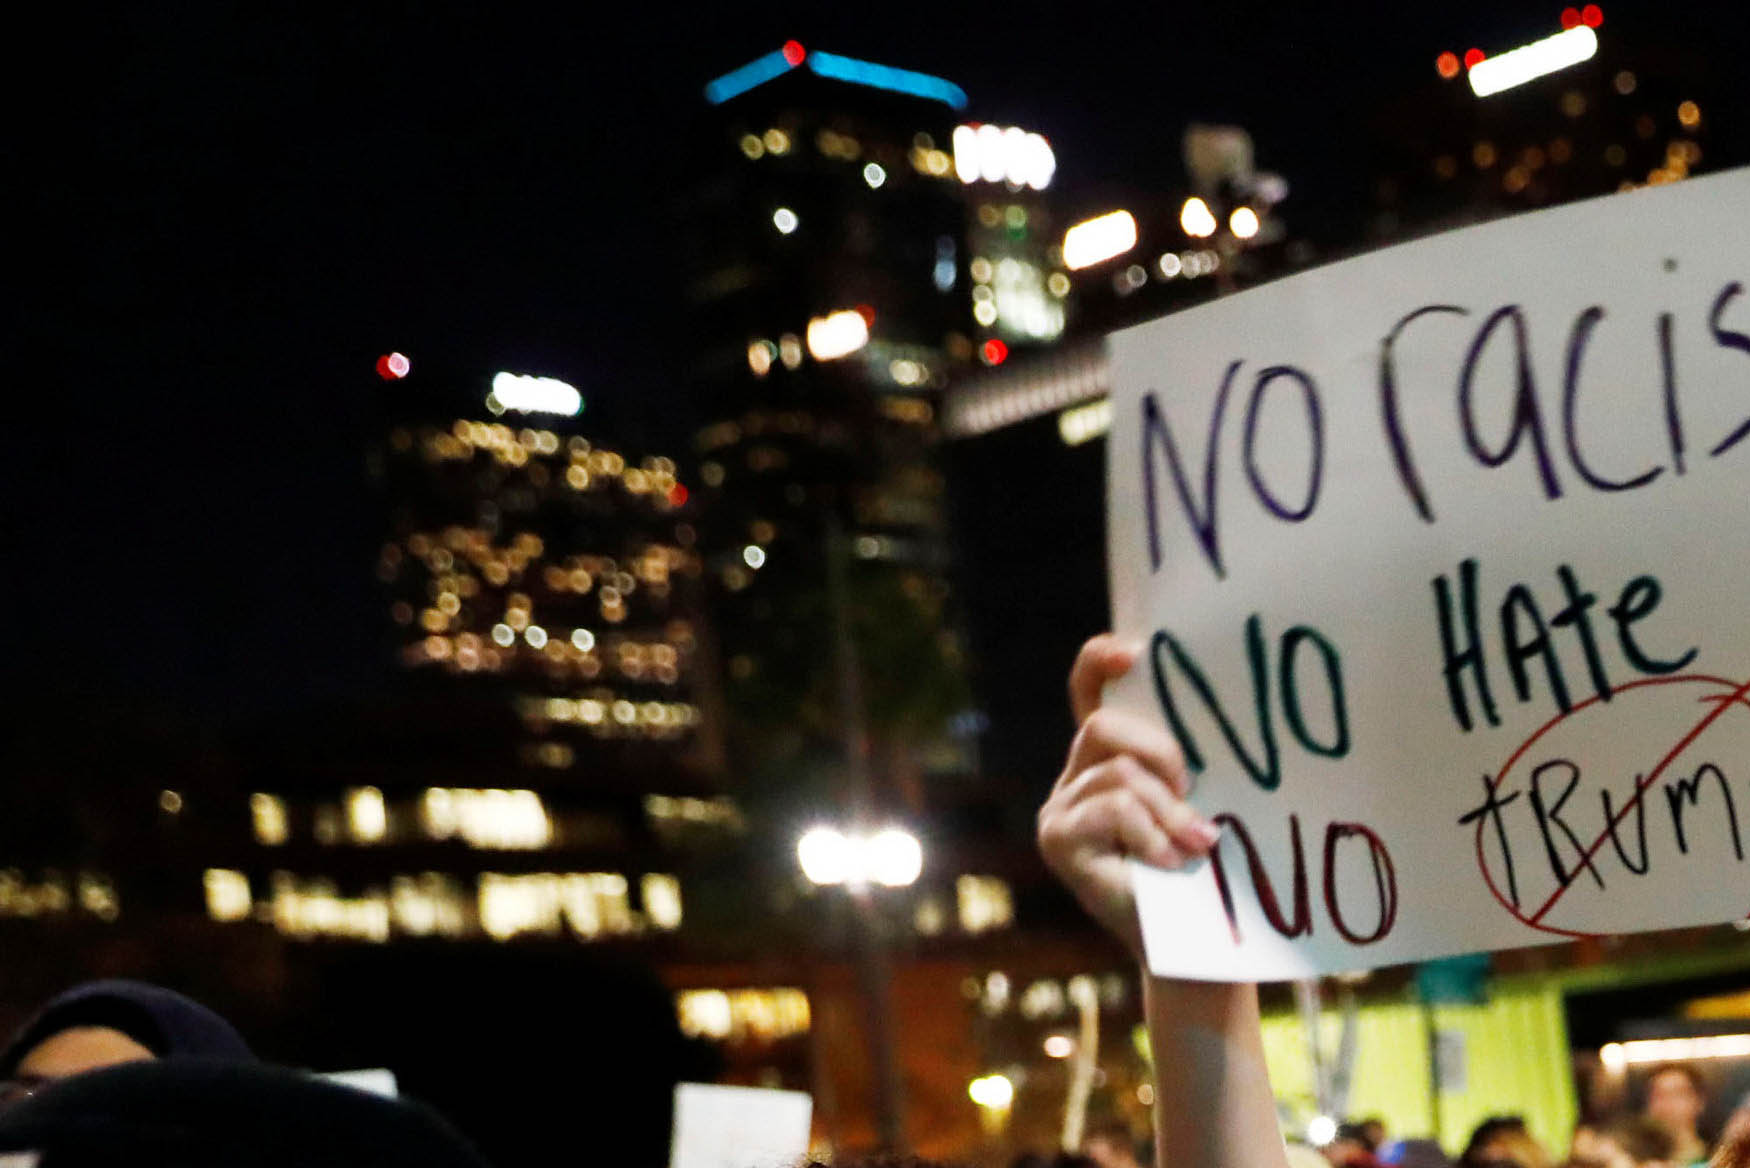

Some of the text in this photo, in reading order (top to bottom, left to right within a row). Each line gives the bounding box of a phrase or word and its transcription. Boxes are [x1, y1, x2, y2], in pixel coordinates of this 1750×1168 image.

[1138, 358, 1325, 582] NO
[1147, 611, 1353, 793] NO
[1206, 810, 1400, 947] NO
